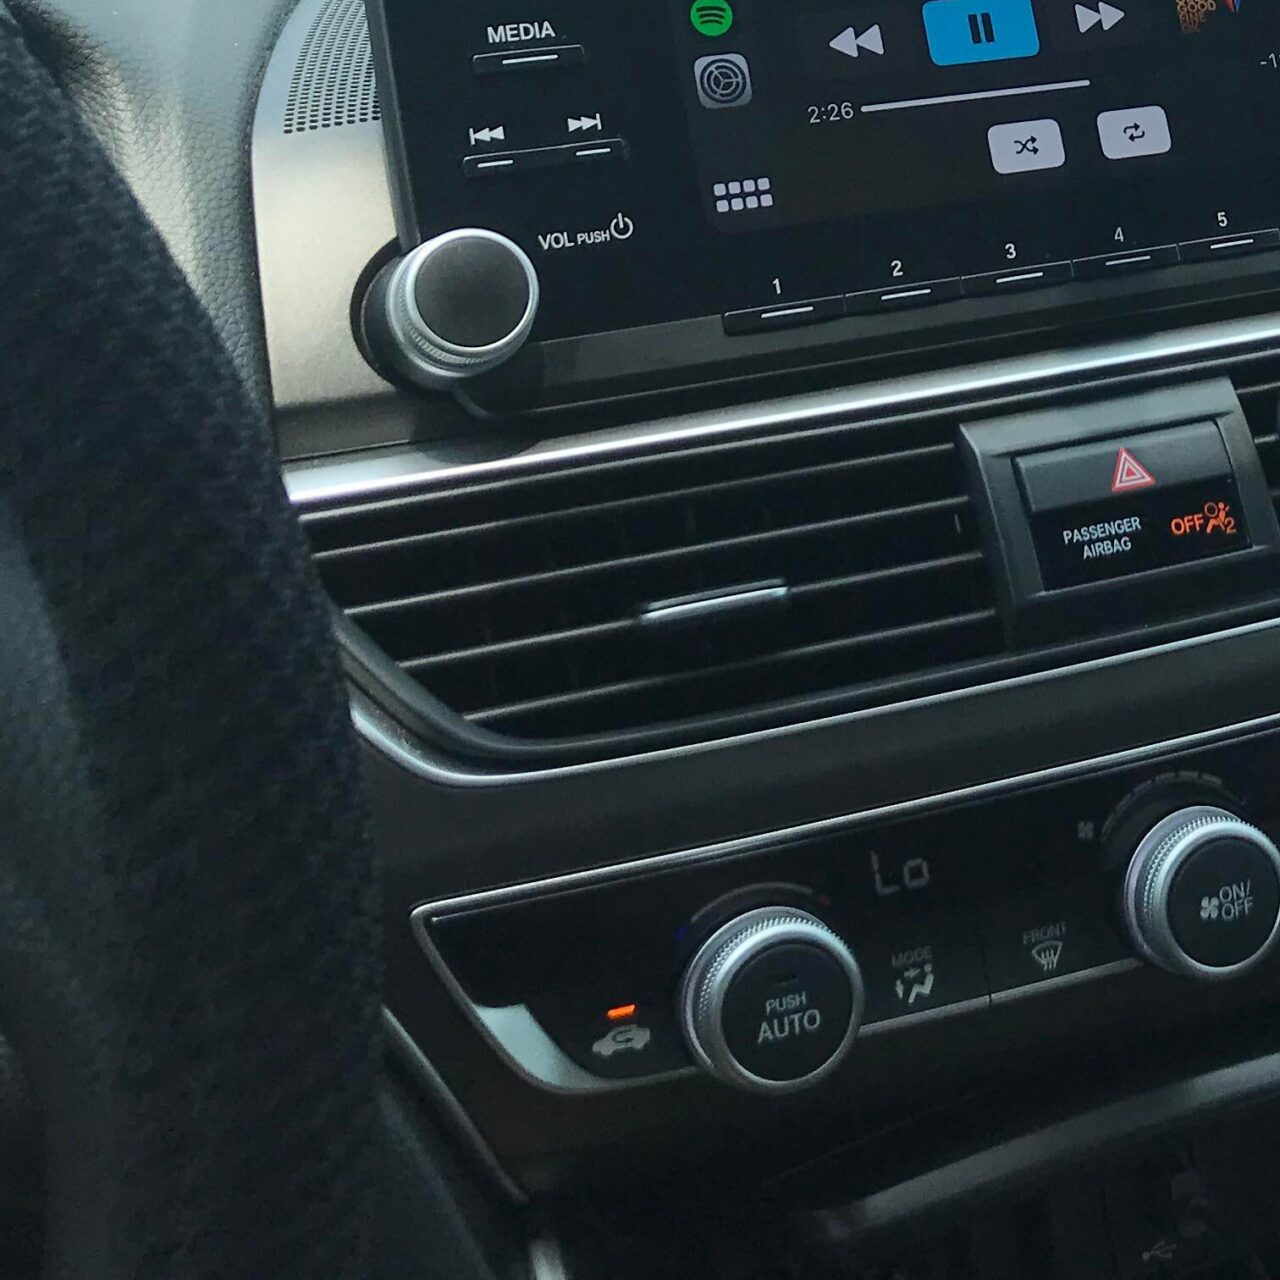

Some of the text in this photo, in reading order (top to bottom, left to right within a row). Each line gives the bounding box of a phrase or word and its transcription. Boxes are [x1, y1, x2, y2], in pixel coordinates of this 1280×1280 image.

[1177, 0, 1217, 13] GOOD
[487, 21, 556, 44] MEDIA
[807, 102, 854, 124] 2:26
[1217, 212, 1228, 227] 5
[537, 229, 611, 250] VOL PUSH
[1114, 227, 1125, 243] 4
[1004, 243, 1017, 259] 3
[890, 260, 904, 277] 2
[772, 278, 782, 295] 1
[1063, 516, 1142, 545] PASSENGER
[1171, 513, 1205, 536] OFF
[1083, 536, 1132, 560] AIRBAG
[871, 850, 930, 896] Lo
[1219, 879, 1251, 904] ON/
[1221, 896, 1253, 920] OFF
[891, 945, 933, 968] MODE
[766, 991, 807, 1015] PUSH
[758, 1009, 821, 1044] AUTO
